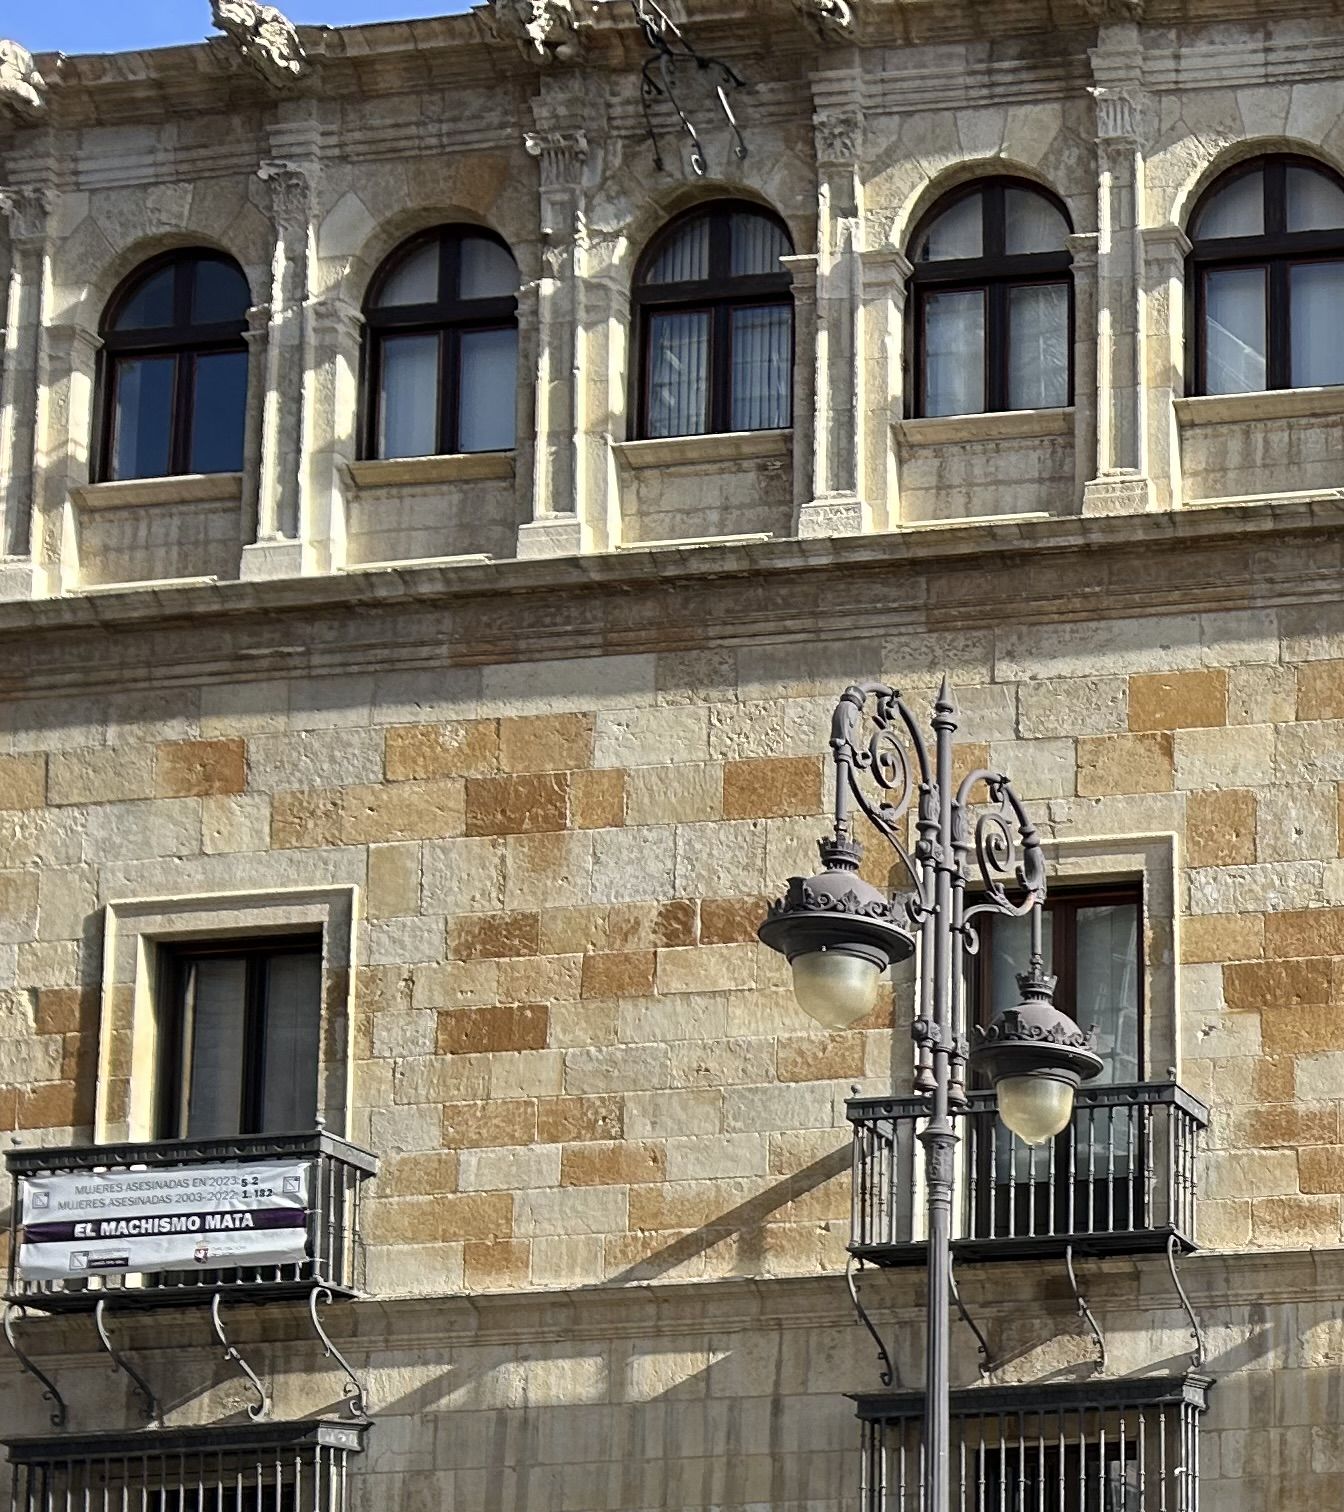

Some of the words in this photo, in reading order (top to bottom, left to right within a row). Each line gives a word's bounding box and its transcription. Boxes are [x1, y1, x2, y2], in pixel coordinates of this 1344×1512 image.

[75, 1183, 122, 1195] MUJERES
[125, 1179, 189, 1191] ASESINADAS
[192, 1179, 206, 1187] EN
[58, 1199, 106, 1210] MUJERES
[108, 1193, 172, 1206] ASESINADAS
[74, 1223, 96, 1237] EL
[100, 1216, 200, 1235] MACHISMO
[205, 1213, 254, 1229] MATA
